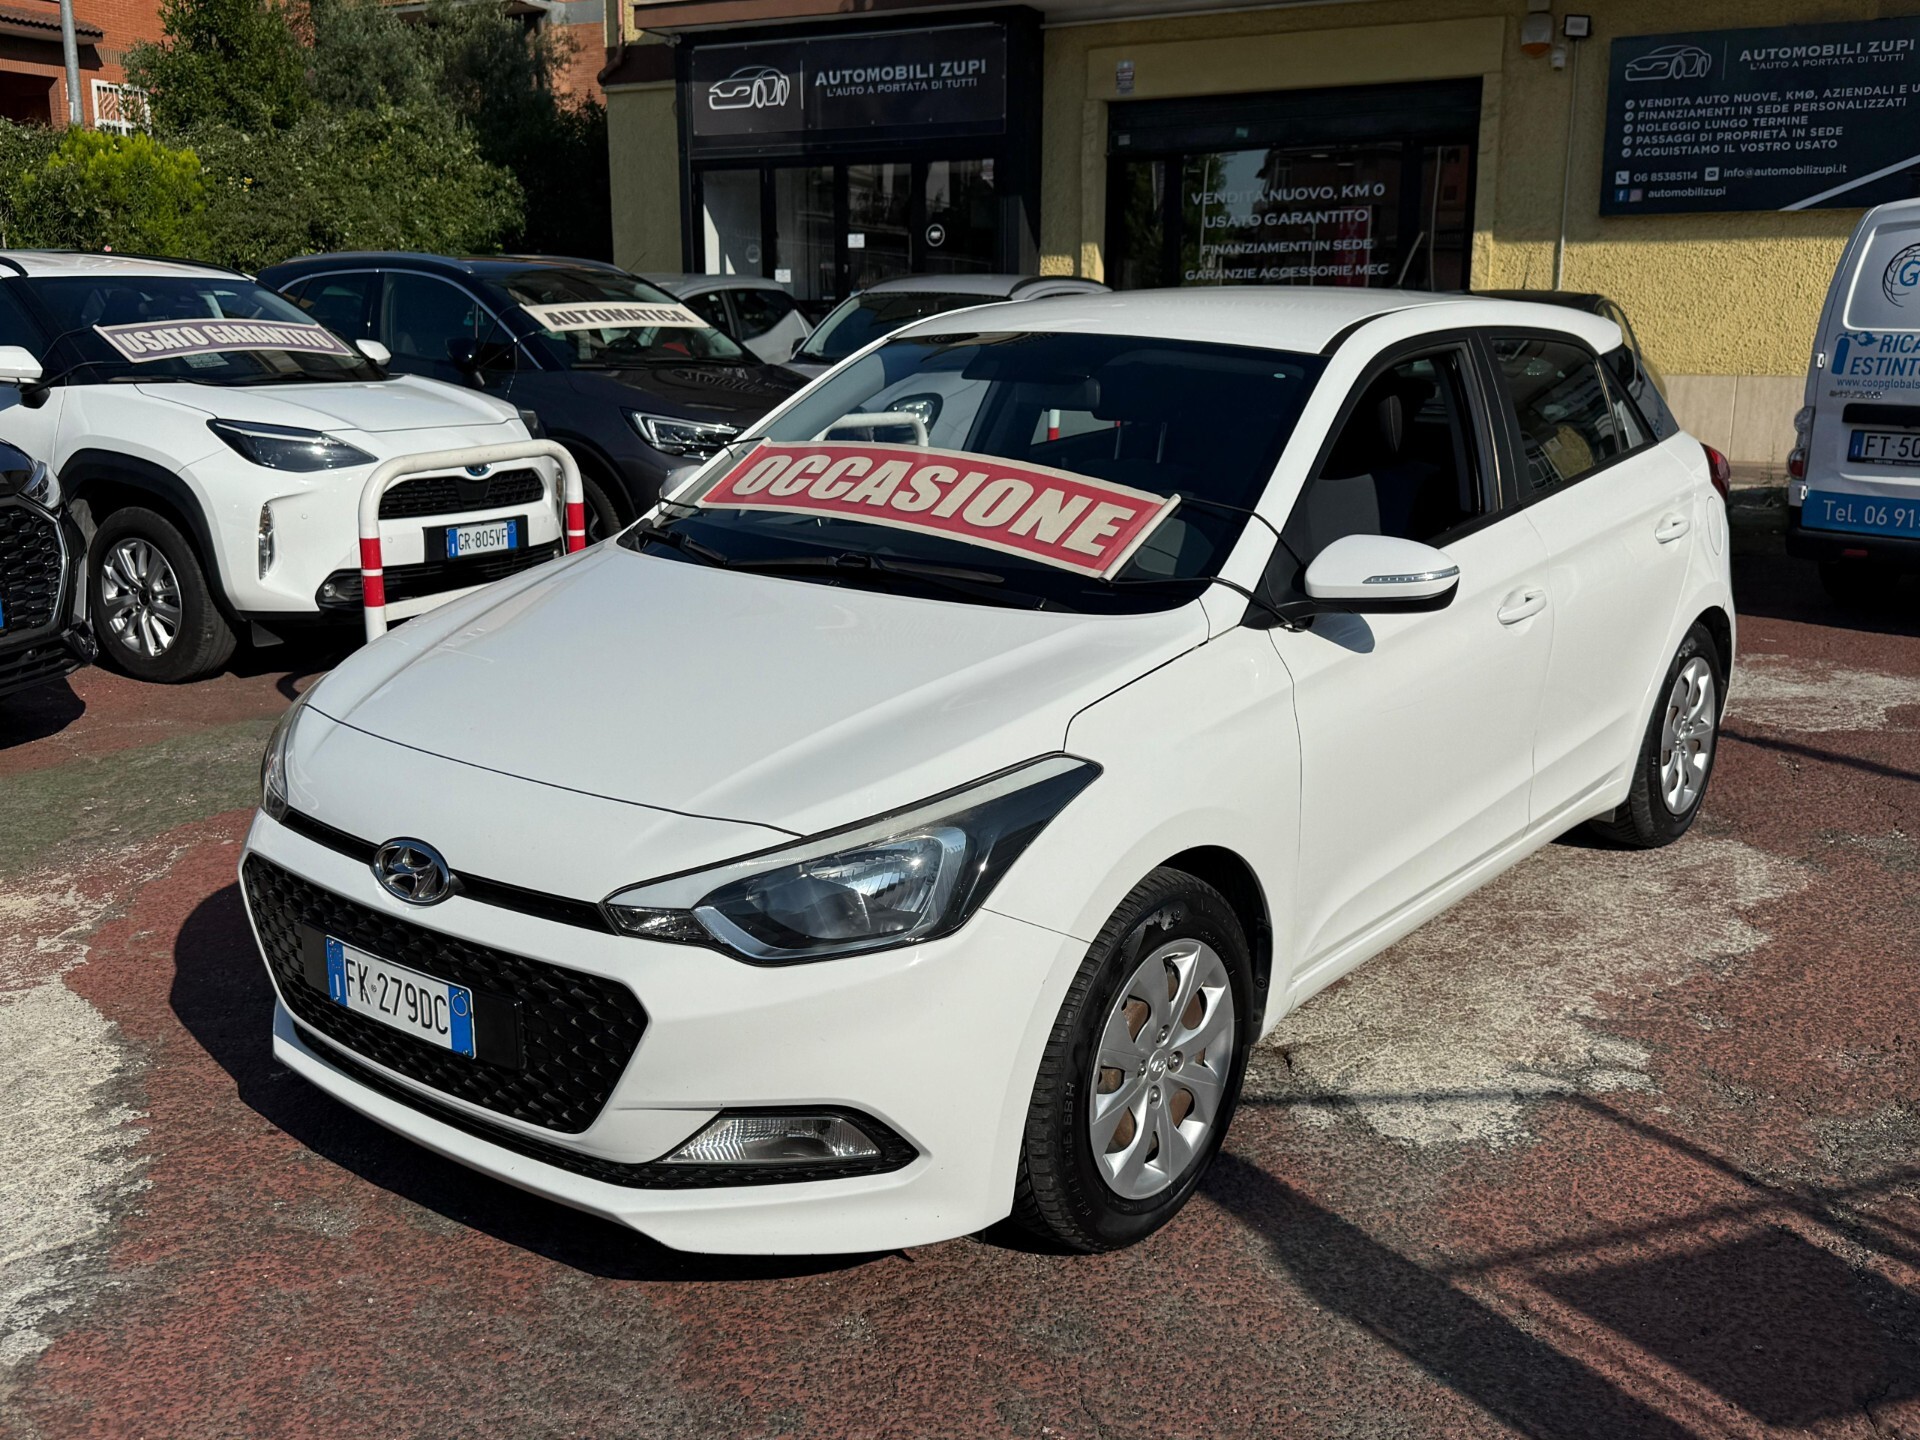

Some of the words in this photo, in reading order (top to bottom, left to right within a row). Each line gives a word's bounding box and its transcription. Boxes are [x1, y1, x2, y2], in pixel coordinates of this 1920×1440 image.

[1739, 42, 1861, 62] AUTOMOBILI
[1868, 39, 1915, 53] ZUPI
[1750, 60, 1789, 70] L'AUTO
[1803, 56, 1854, 67] PORTATA
[1872, 53, 1905, 62] TUTTI
[815, 63, 934, 87] AUTOMOBILI
[940, 59, 986, 76] ZUPI
[827, 84, 863, 97] L'AUTO
[867, 84, 875, 95] A
[877, 81, 928, 94] PORTATA
[931, 79, 943, 90] DI
[946, 77, 977, 89] TUTTI
[1639, 97, 1691, 108] VENDITA
[1695, 94, 1729, 105] AUTO
[1734, 91, 1781, 103] NUOVE,
[1823, 85, 1895, 98] AZIENDALI
[1900, 84, 1908, 93] E
[1637, 107, 1735, 121] FINANZIAMENTI
[1739, 105, 1752, 115] IN
[1756, 104, 1790, 114] SEDE
[1793, 97, 1907, 112] PERSONALIZZATI
[1636, 121, 1700, 133] NOLEGGIO
[1704, 118, 1748, 129] LUNGO
[1753, 115, 1809, 127] TERMINE
[1635, 133, 1695, 145] PASSAGGI
[1699, 132, 1712, 142] DI
[1792, 128, 1805, 138] IN
[1810, 126, 1843, 137] SEDE
[1635, 144, 1720, 157] ACQUISTIAMO
[1724, 144, 1735, 153] IL
[1740, 141, 1791, 152] VOSTRO
[1795, 139, 1838, 150] USATO
[1633, 172, 1648, 182] 06
[1191, 188, 1265, 205] VENDITA
[1269, 186, 1338, 202] NUOVO,
[1341, 184, 1369, 199] KM
[1204, 214, 1262, 229] USATO
[1264, 209, 1369, 226] GARANTITO
[1201, 241, 1312, 255] FINANZIAMENTI
[1315, 240, 1330, 251] IN
[1332, 238, 1373, 250] SEDE
[1185, 268, 1257, 281] GARANZIE
[1259, 265, 1353, 279] ACCESSORIE
[1355, 263, 1390, 276] MEC
[544, 308, 694, 326] AUTOMATICA
[115, 326, 210, 354] USATO
[202, 325, 335, 350] GARANTITO
[1850, 357, 1920, 377] ESTINT
[731, 453, 1136, 557] OCCASIONE
[1823, 499, 1857, 524] Tel.
[1864, 505, 1888, 526] 06
[1894, 508, 1920, 529] 91
